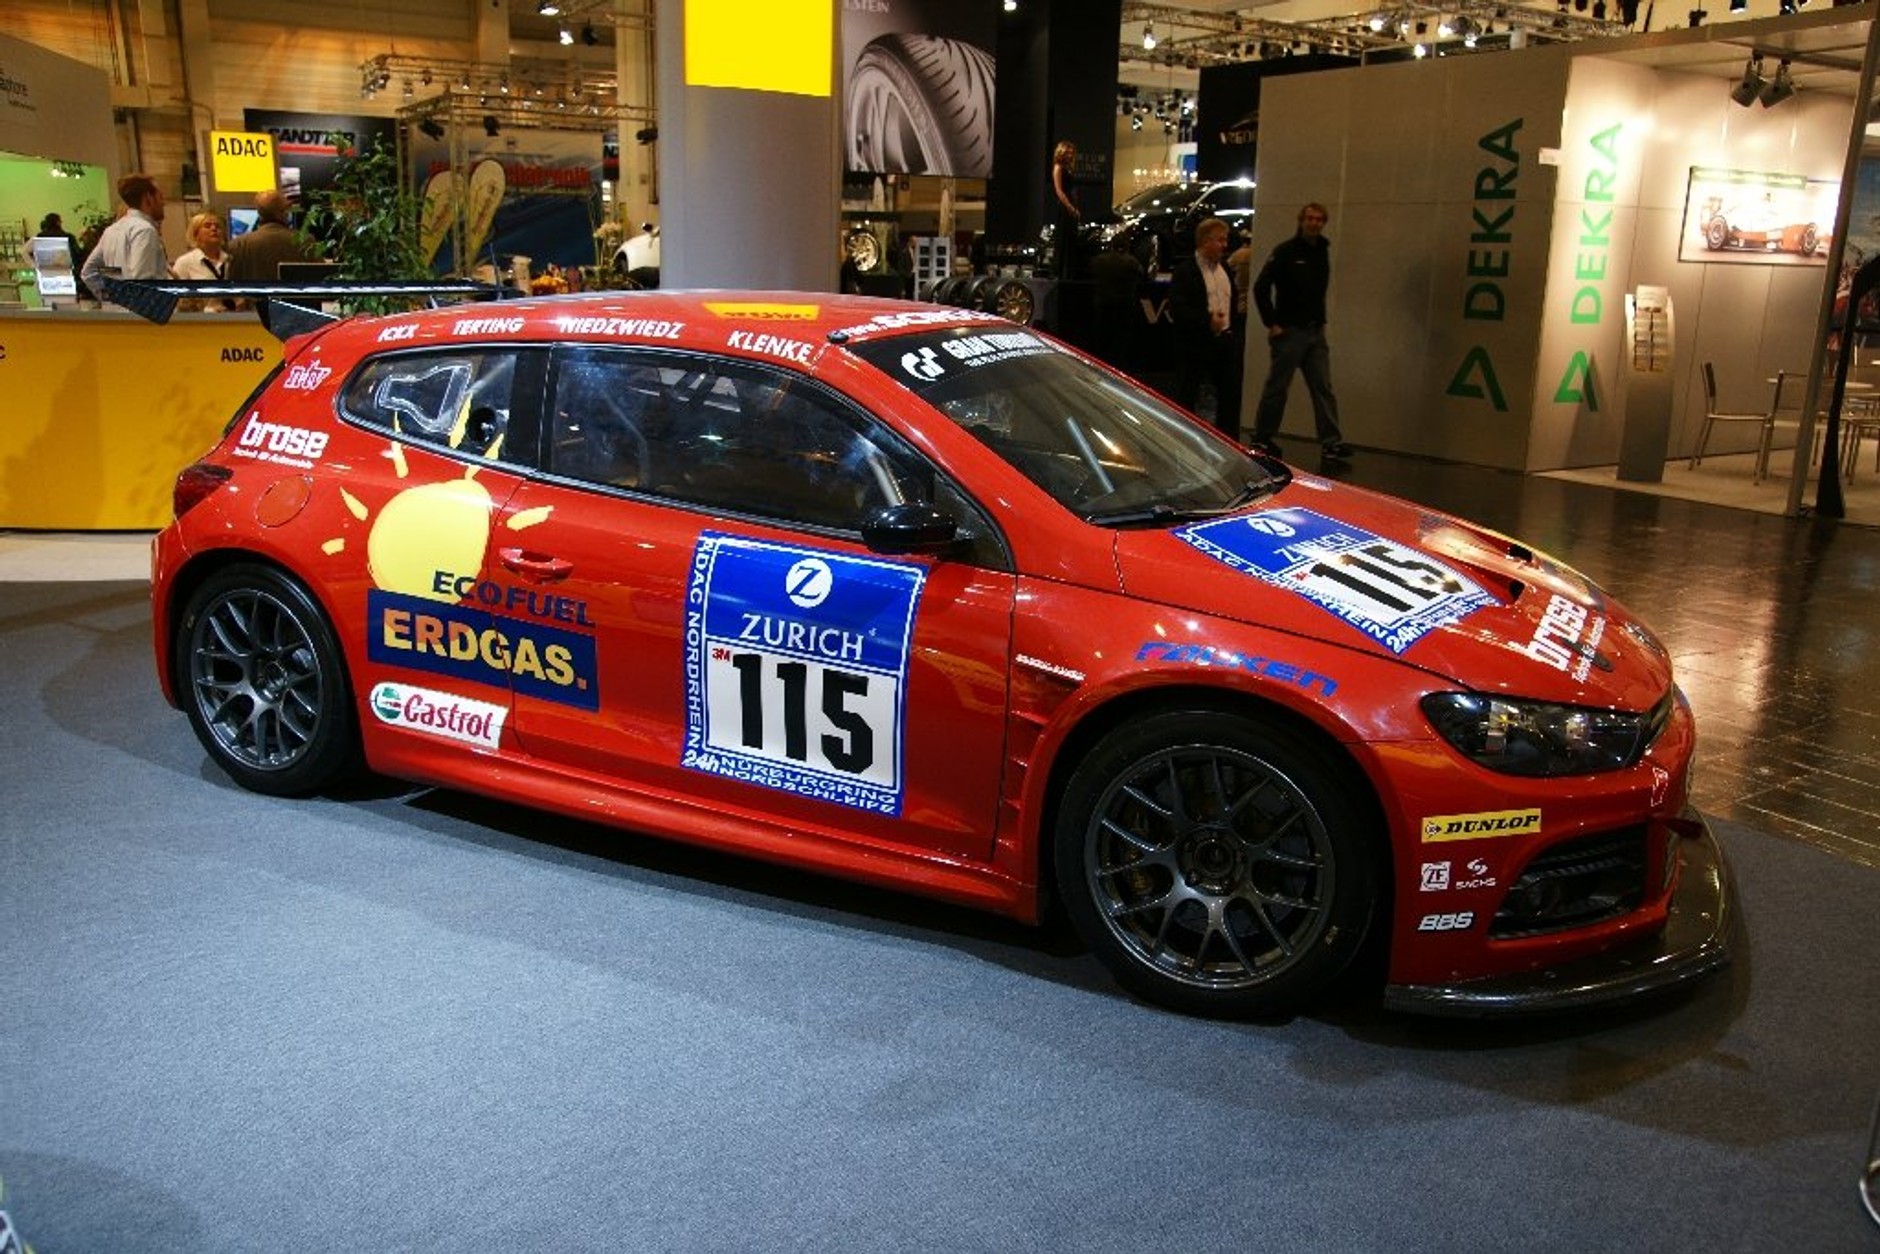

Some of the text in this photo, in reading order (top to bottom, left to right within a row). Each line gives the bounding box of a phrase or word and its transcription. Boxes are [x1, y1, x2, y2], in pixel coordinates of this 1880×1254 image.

[217, 138, 268, 157] ADAC
[1464, 118, 1523, 322] DEKRA
[1571, 122, 1622, 323] DEKRA
[452, 317, 525, 335] TERTING
[559, 318, 686, 339] NIEDZWIEDZ
[220, 347, 264, 362] ADAC
[727, 330, 815, 366] KLENKE
[240, 411, 329, 458] brose
[1175, 532, 1241, 567] ADAC
[1310, 544, 1463, 612] 115
[384, 608, 587, 690] ERDGAS.
[686, 537, 714, 750] ADAC NORDRHEIN
[739, 613, 865, 661] ZURICH
[1507, 594, 1587, 672] brose
[711, 648, 731, 662] 3M
[403, 694, 494, 741] Castrol
[732, 654, 873, 774] 115
[682, 750, 720, 772] 24h
[1445, 815, 1539, 834] DUNLOP
[1456, 878, 1496, 889] SACHS
[1418, 912, 1473, 930] BBS
